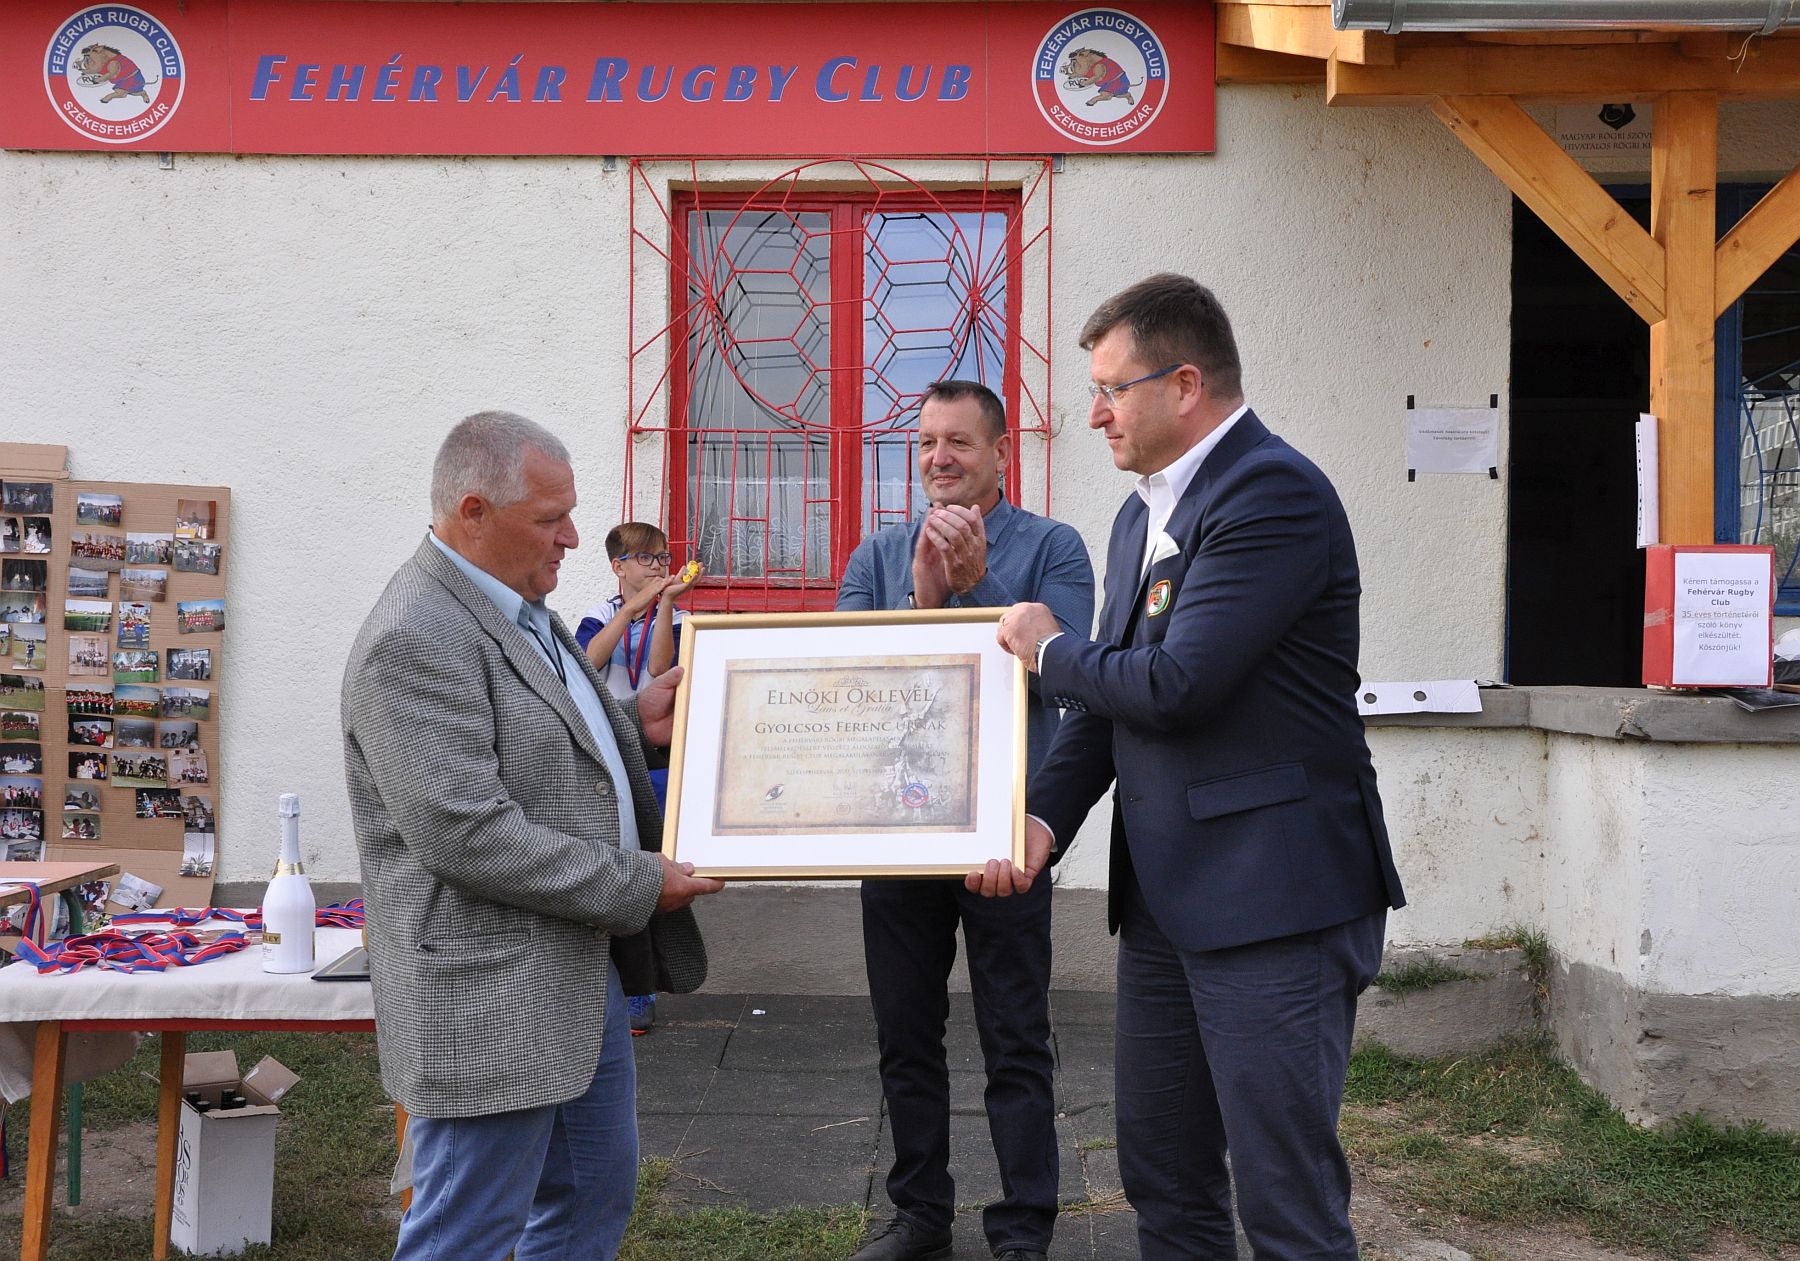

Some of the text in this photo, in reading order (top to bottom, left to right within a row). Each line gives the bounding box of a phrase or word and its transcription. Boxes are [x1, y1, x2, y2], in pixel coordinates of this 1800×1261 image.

[52, 11, 177, 76] FEHÉRVÁR RUGBY CLUB
[1040, 15, 1162, 79] FEHÉRVÁR RUGBY CLUB
[249, 52, 972, 104] FEHÉRVÁR RUGBY CLUB
[63, 101, 169, 136] SZÉKESFEHÉRVÁR
[1050, 104, 1153, 137] SZÉKESFEHÉRVÁR
[1560, 132, 1596, 141] MAGYAR
[1564, 142, 1611, 151] HIVATALOS
[1683, 577, 1708, 585] Kérem
[1710, 577, 1752, 587] támogassa
[1687, 588, 1755, 597] Fehérvár Rugby
[767, 685, 934, 705] ELNÖKI OKLEVÉL
[754, 722, 831, 734] GYOLCSOS
[836, 721, 892, 733] FERENC
